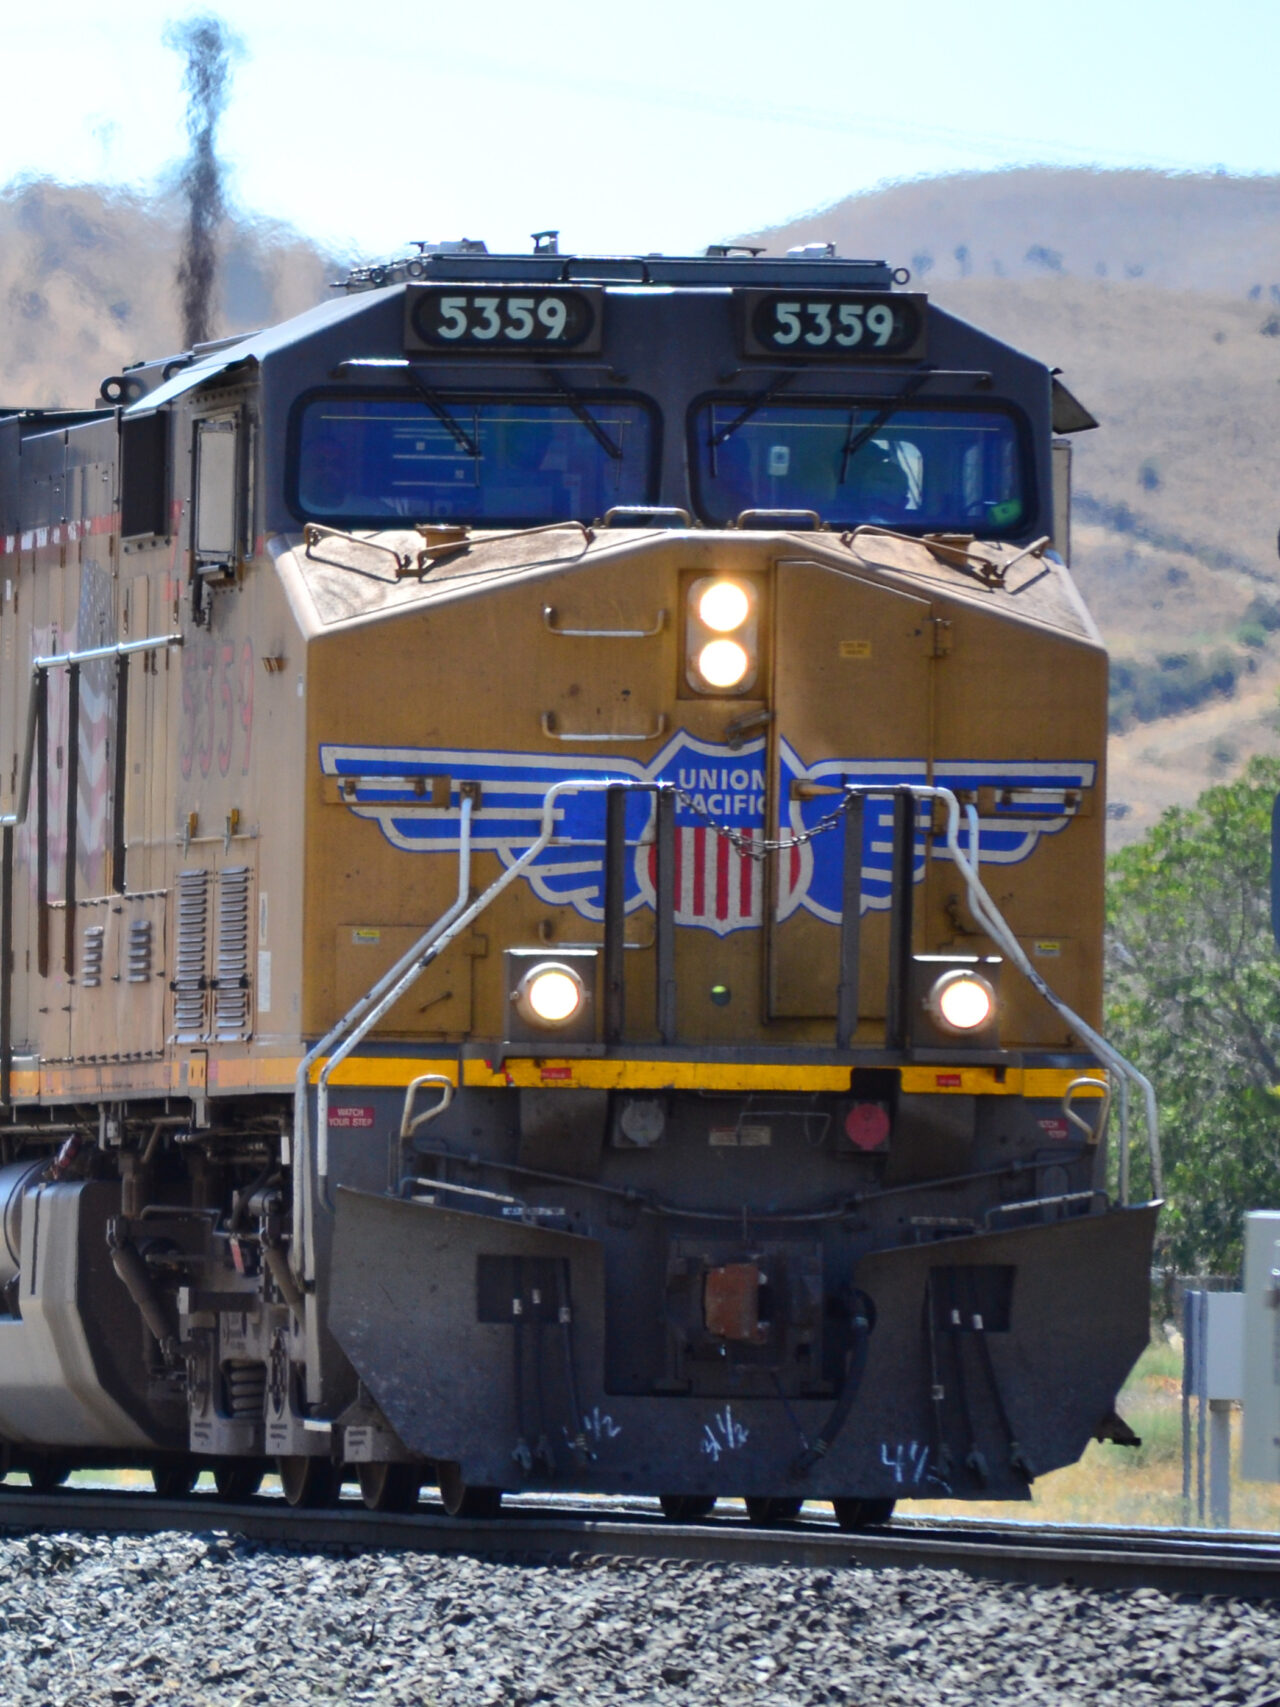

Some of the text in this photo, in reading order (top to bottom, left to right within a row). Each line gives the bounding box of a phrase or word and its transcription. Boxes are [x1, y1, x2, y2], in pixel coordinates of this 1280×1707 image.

[437, 297, 567, 340] 5359
[773, 303, 894, 346] 5359
[678, 768, 766, 791] UNION
[328, 1117, 373, 1127] YOUR STEP
[337, 1107, 364, 1117] WATCH
